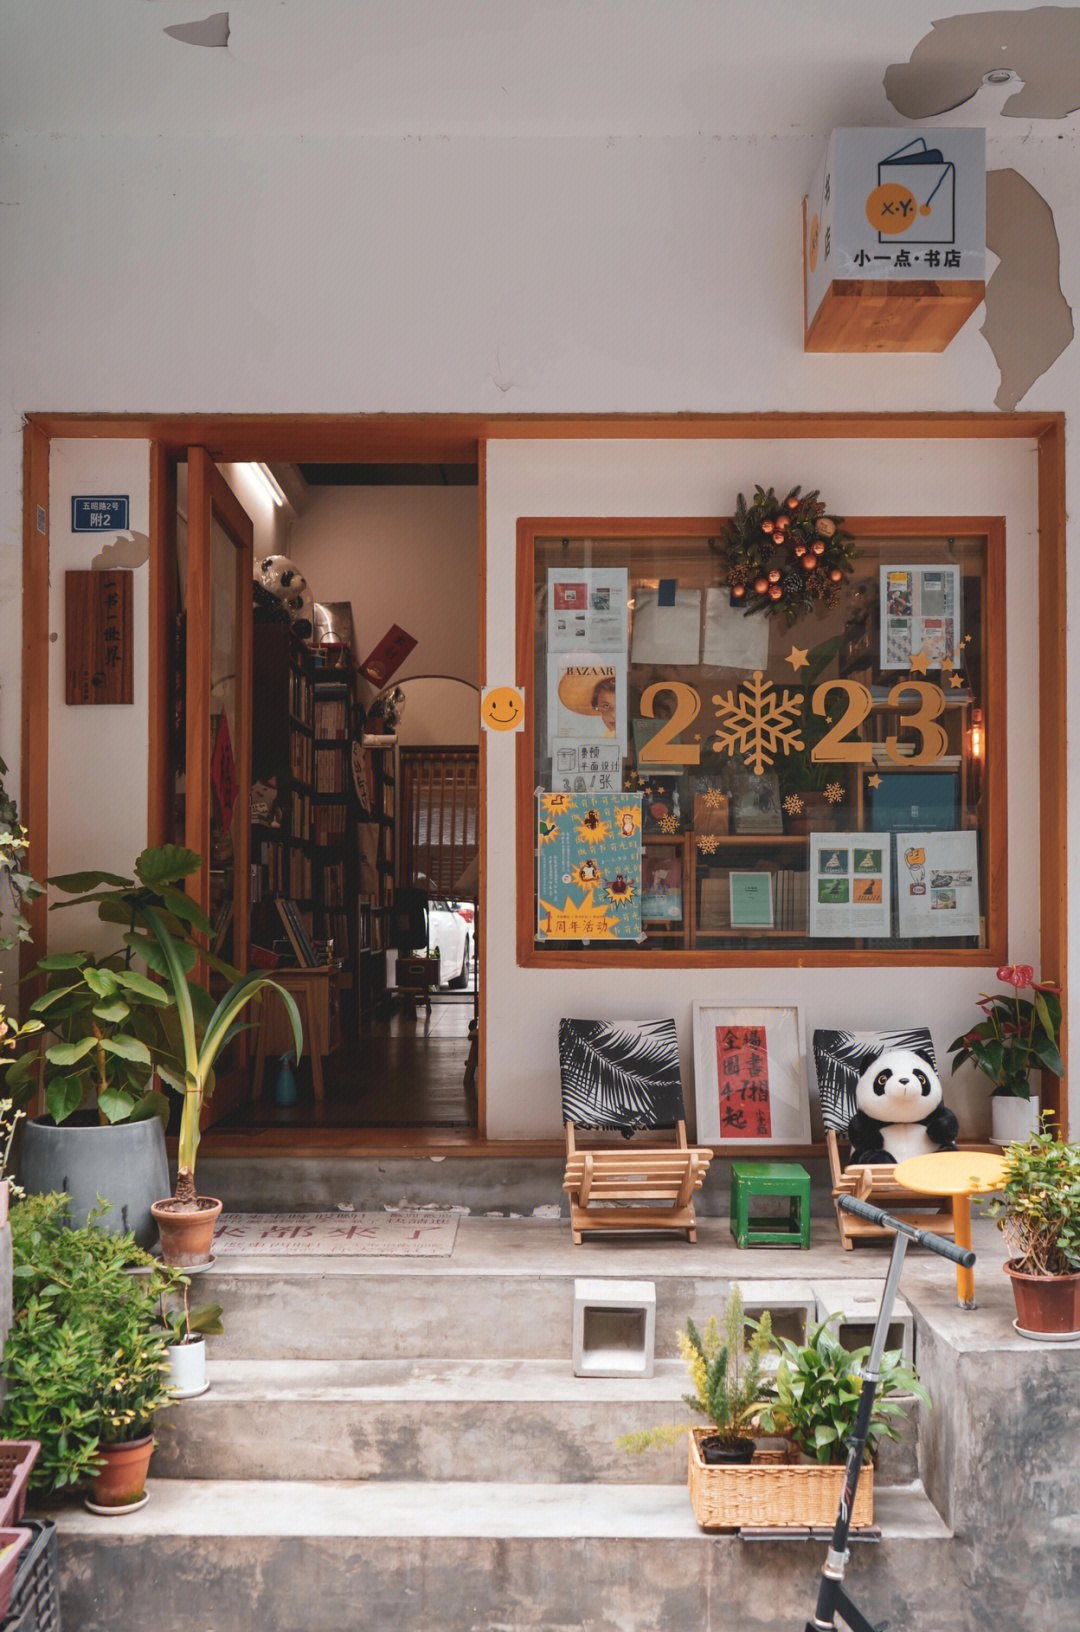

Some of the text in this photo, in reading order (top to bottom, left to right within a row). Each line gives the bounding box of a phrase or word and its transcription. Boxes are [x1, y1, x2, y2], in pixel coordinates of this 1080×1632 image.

[853, 249, 962, 268] 小一点·书店
[90, 512, 111, 527] 附2
[103, 581, 122, 668] 一书一世界
[566, 667, 614, 676] BAZAAR
[721, 1106, 747, 1130] 起
